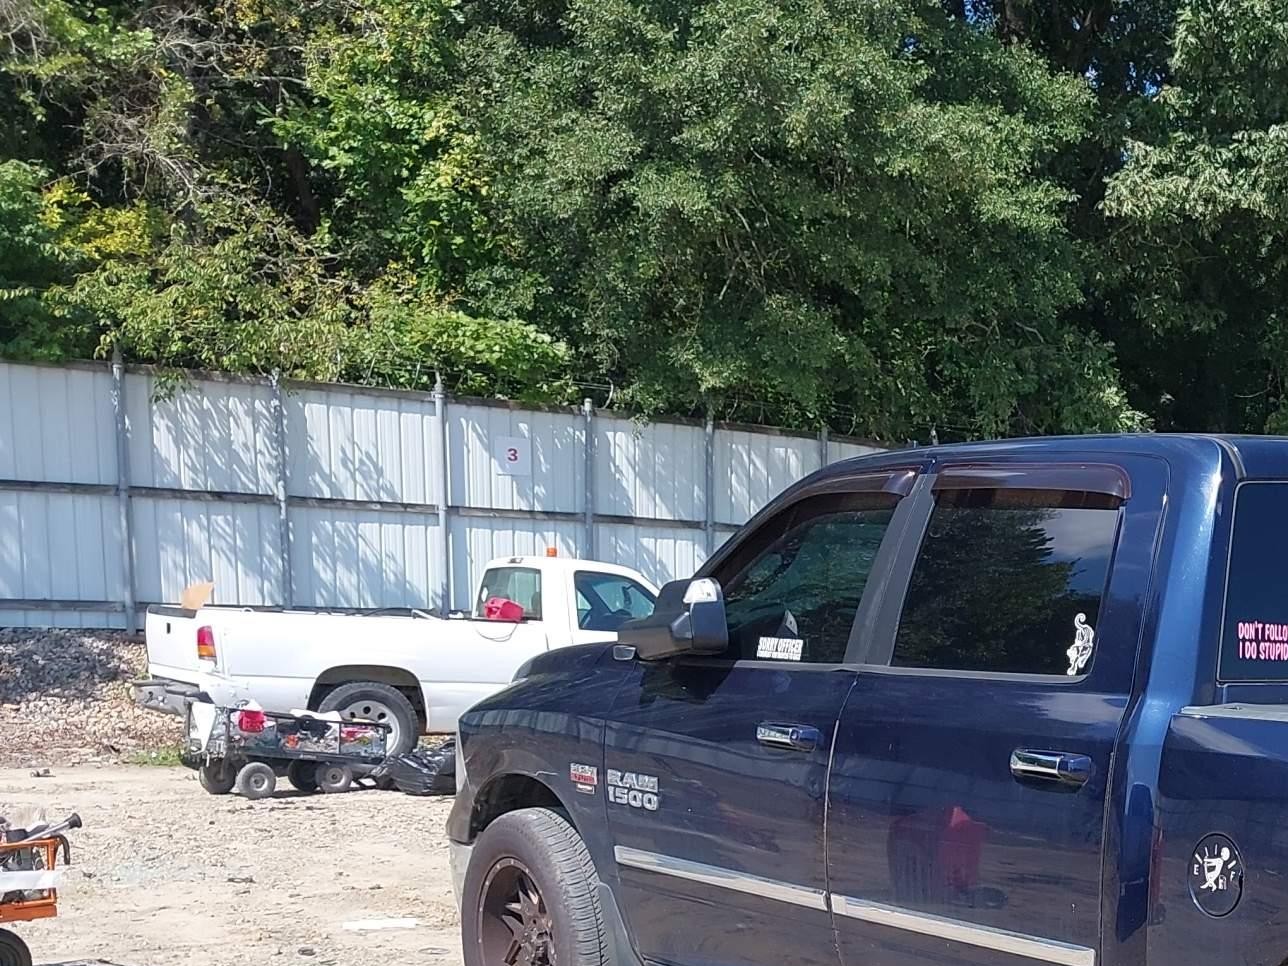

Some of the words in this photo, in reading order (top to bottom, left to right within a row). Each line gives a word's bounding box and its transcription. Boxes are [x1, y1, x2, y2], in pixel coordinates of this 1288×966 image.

[507, 447, 518, 461] 3
[1238, 620, 1263, 640] DON'T
[758, 637, 779, 652] SORRY
[778, 638, 803, 655] OFFICER
[1239, 641, 1243, 659] I
[1245, 641, 1257, 659] DO
[1259, 642, 1288, 661] STUPID
[607, 768, 658, 793] RAM
[608, 786, 658, 811] 1500
[1193, 863, 1199, 875] E
[1230, 870, 1236, 882] F
